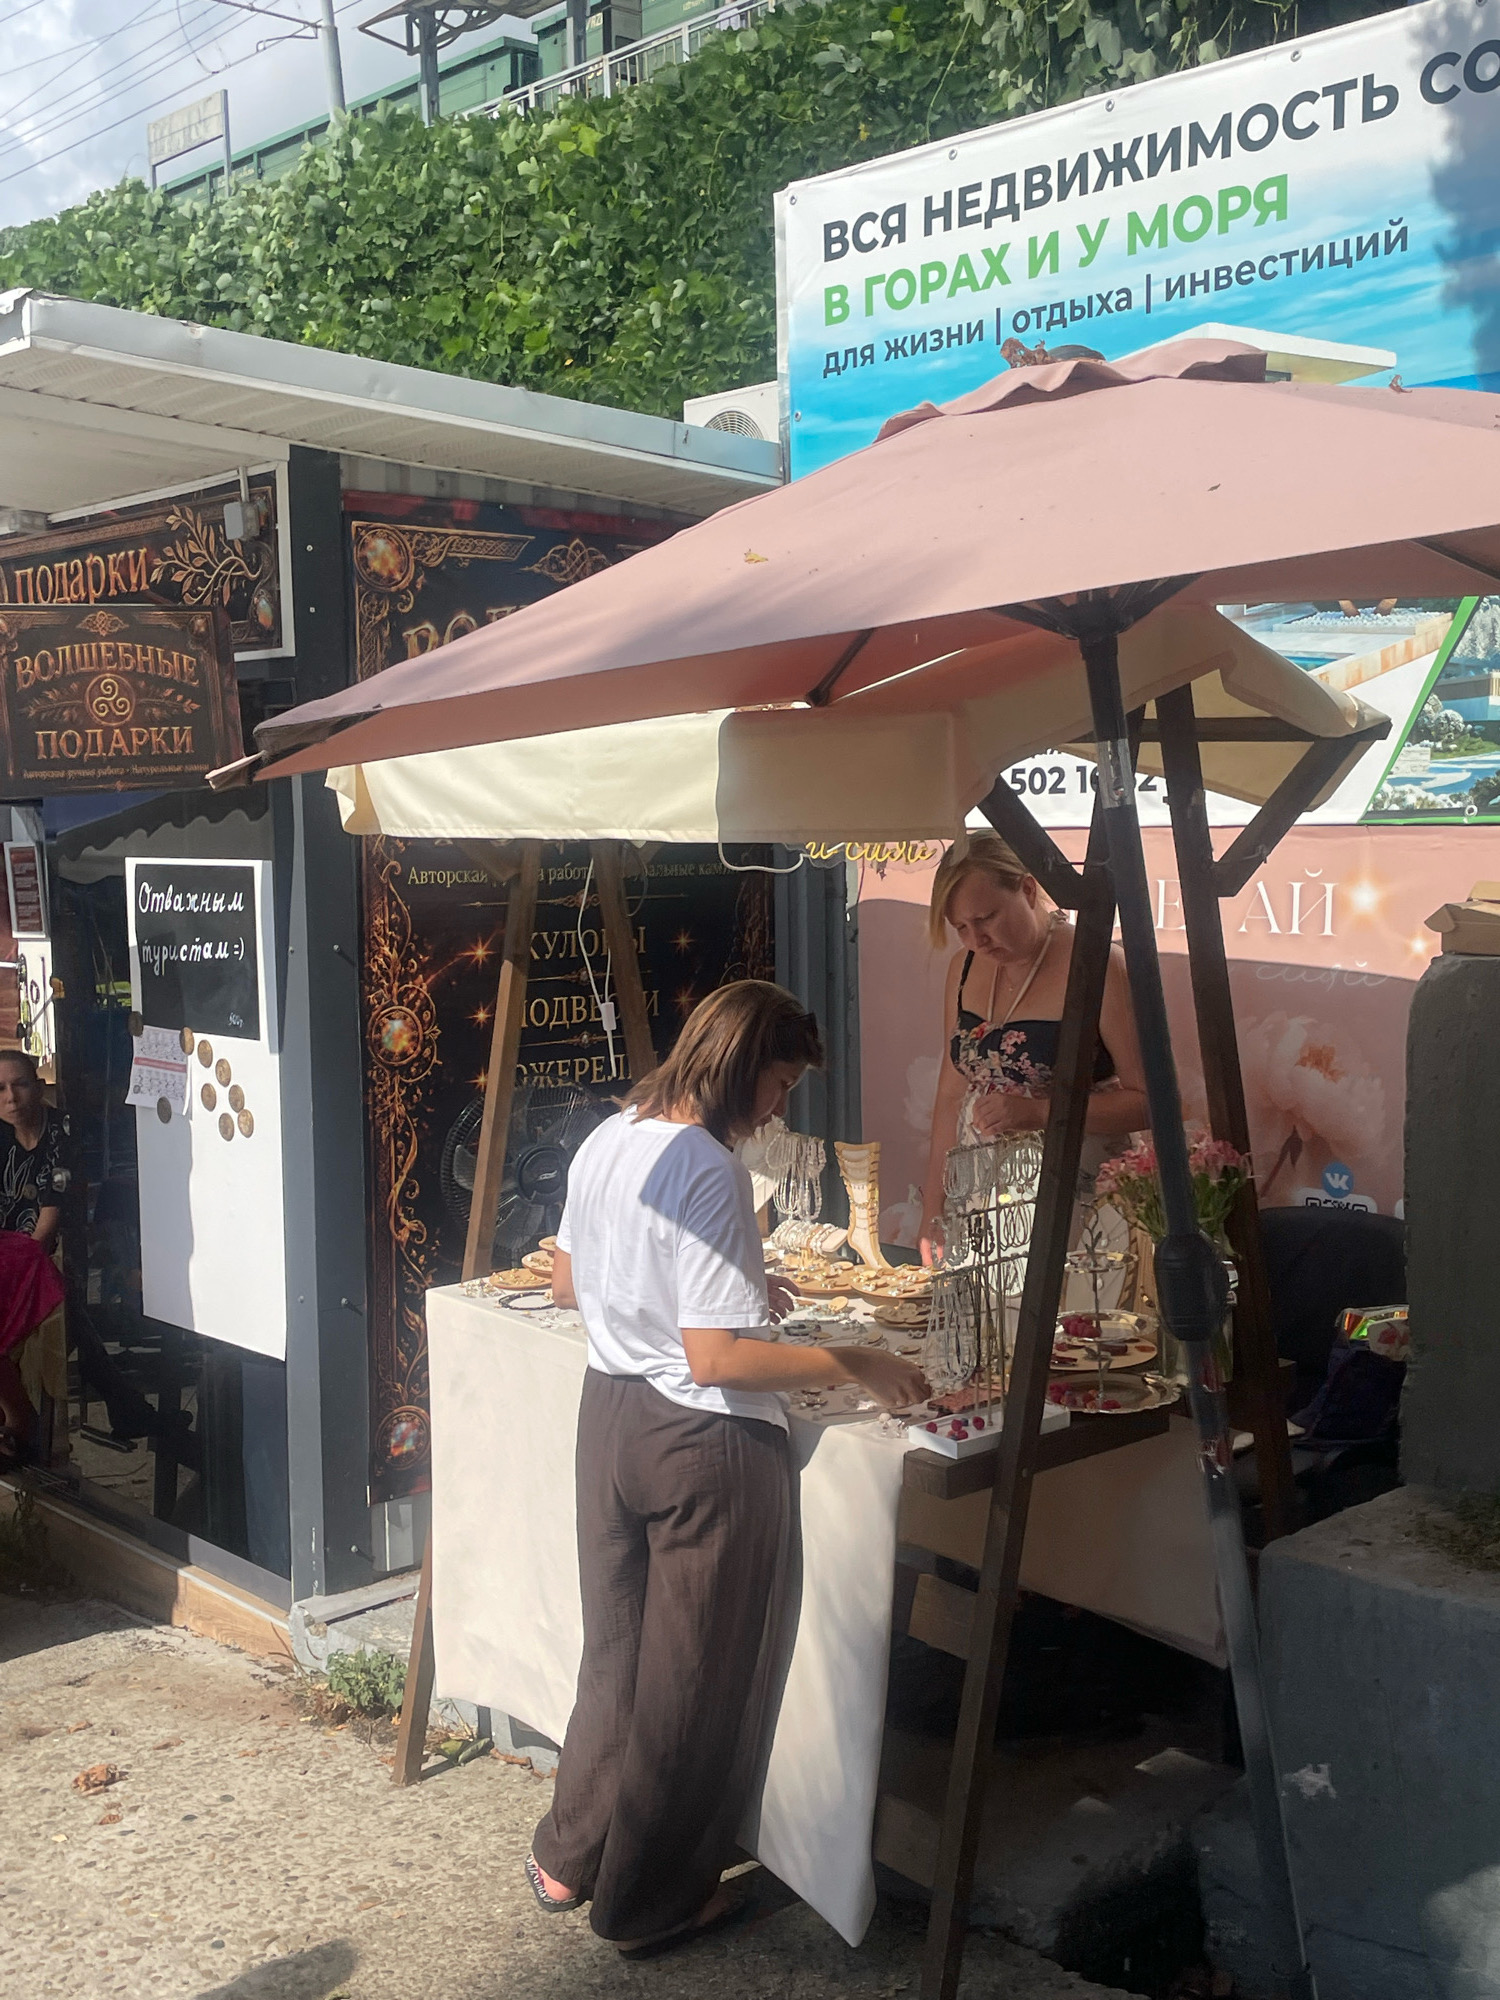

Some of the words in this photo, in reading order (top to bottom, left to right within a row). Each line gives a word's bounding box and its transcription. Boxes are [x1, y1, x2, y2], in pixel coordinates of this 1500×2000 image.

[822, 203, 907, 262] ВСЯ
[924, 73, 1399, 232] НЕДВИЖИМОСТЬ
[1420, 39, 1500, 105] СО
[824, 285, 850, 326] В
[864, 244, 1012, 320] ГОРАХ
[1027, 229, 1060, 279] И
[1079, 217, 1110, 267] У
[1126, 173, 1289, 256] МОРЯ
[822, 342, 875, 380] для
[884, 314, 985, 362] жизни
[1011, 282, 1133, 343] отдыха
[1164, 217, 1409, 301] инвестиций
[14, 641, 200, 692] ВОЛШЕБНЫЕ
[35, 726, 195, 761] ПОДАРКИ
[1011, 766, 1066, 796] 502
[407, 866, 488, 888] Авторская
[139, 882, 244, 913] Отважным
[142, 937, 229, 976] туристам
